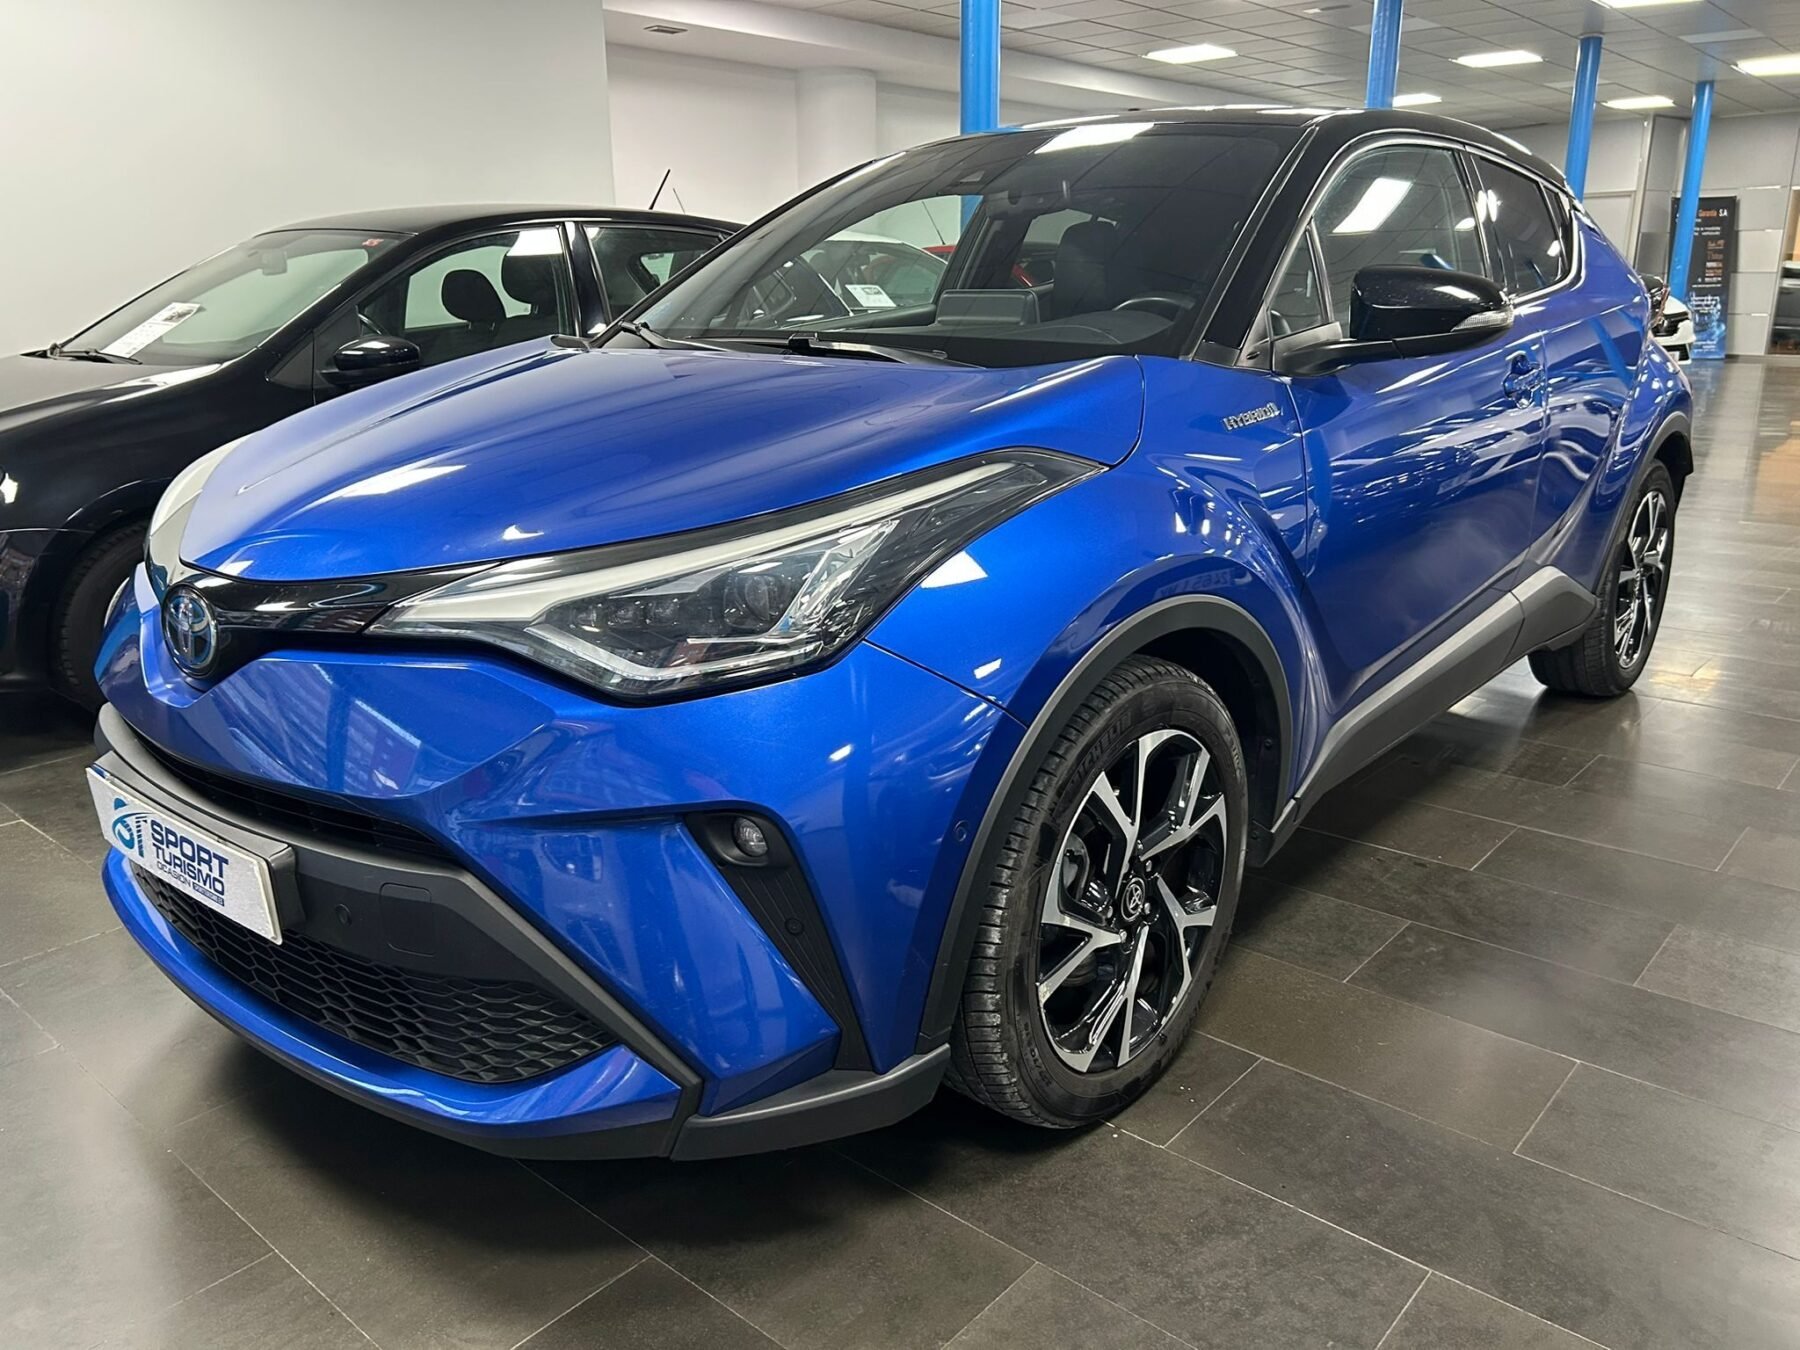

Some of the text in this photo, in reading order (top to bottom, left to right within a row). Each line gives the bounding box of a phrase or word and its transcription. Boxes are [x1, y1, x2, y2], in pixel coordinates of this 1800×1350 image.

[1223, 402, 1280, 430] HYBRID
[150, 819, 229, 878] SPORT
[152, 843, 225, 896] TURISMO
